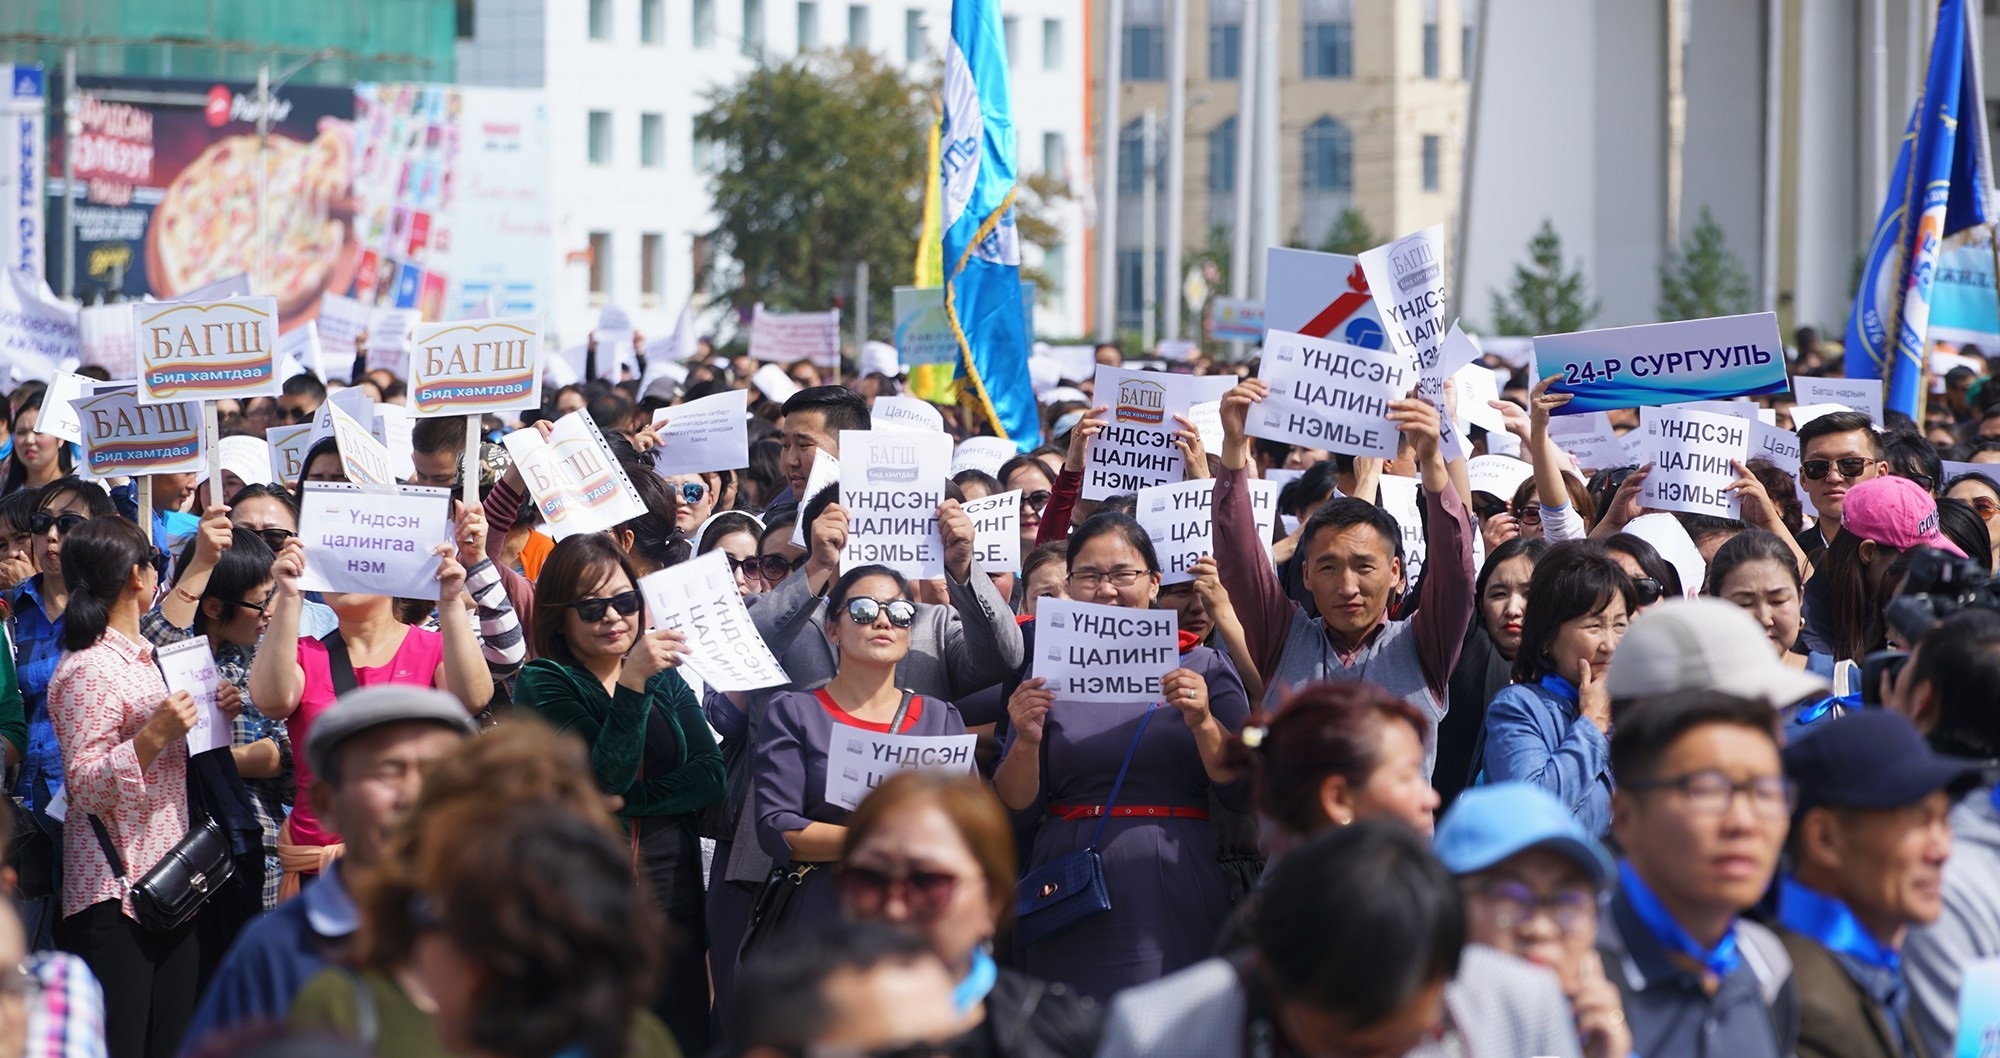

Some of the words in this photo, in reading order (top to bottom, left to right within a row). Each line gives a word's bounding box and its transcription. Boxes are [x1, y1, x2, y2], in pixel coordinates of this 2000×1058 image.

[1393, 244, 1434, 275] БАГШ
[151, 321, 263, 359] БАГШ
[424, 339, 528, 376] БАГШ
[1302, 347, 1403, 386] ҮНДСЭН
[1564, 359, 1622, 385] 24-Р
[1630, 344, 1772, 378] СУРГУУЛЬ
[153, 372, 186, 384] Бид
[191, 367, 262, 381] хамтдаа
[422, 388, 452, 400] Бид
[456, 384, 523, 397] хамтдаа
[1121, 387, 1163, 408] БАГШ
[90, 402, 191, 439] БАГШ
[1118, 409, 1131, 418] Бид
[1132, 411, 1160, 421] хамтдаа
[1288, 414, 1384, 450] НЭМЬЕ.
[1660, 419, 1743, 446] ҮНДСЭН
[95, 451, 123, 463] Бид
[127, 447, 190, 461] хамтдаа
[870, 445, 915, 465] БАГШ
[1092, 447, 1179, 472] ЦАЛИНГ
[528, 446, 603, 493] БАГШ
[869, 470, 884, 480] Бид
[885, 470, 915, 480] хамтдаа
[846, 491, 939, 510] ҮНДСЭН
[961, 496, 1013, 514] СЭН
[350, 509, 420, 529] Үндсэн
[323, 533, 415, 553] цалингаа
[848, 544, 935, 562] НЭМЬЕ.
[347, 558, 386, 574] нэм
[713, 594, 772, 681] ҮНДСЭН
[1073, 612, 1171, 640] ҮНДСЭН
[690, 604, 750, 685] ЦАЛИНГ
[1069, 646, 1173, 668] ЦАЛИНГ
[872, 742, 968, 769] ҮНДСЭН
